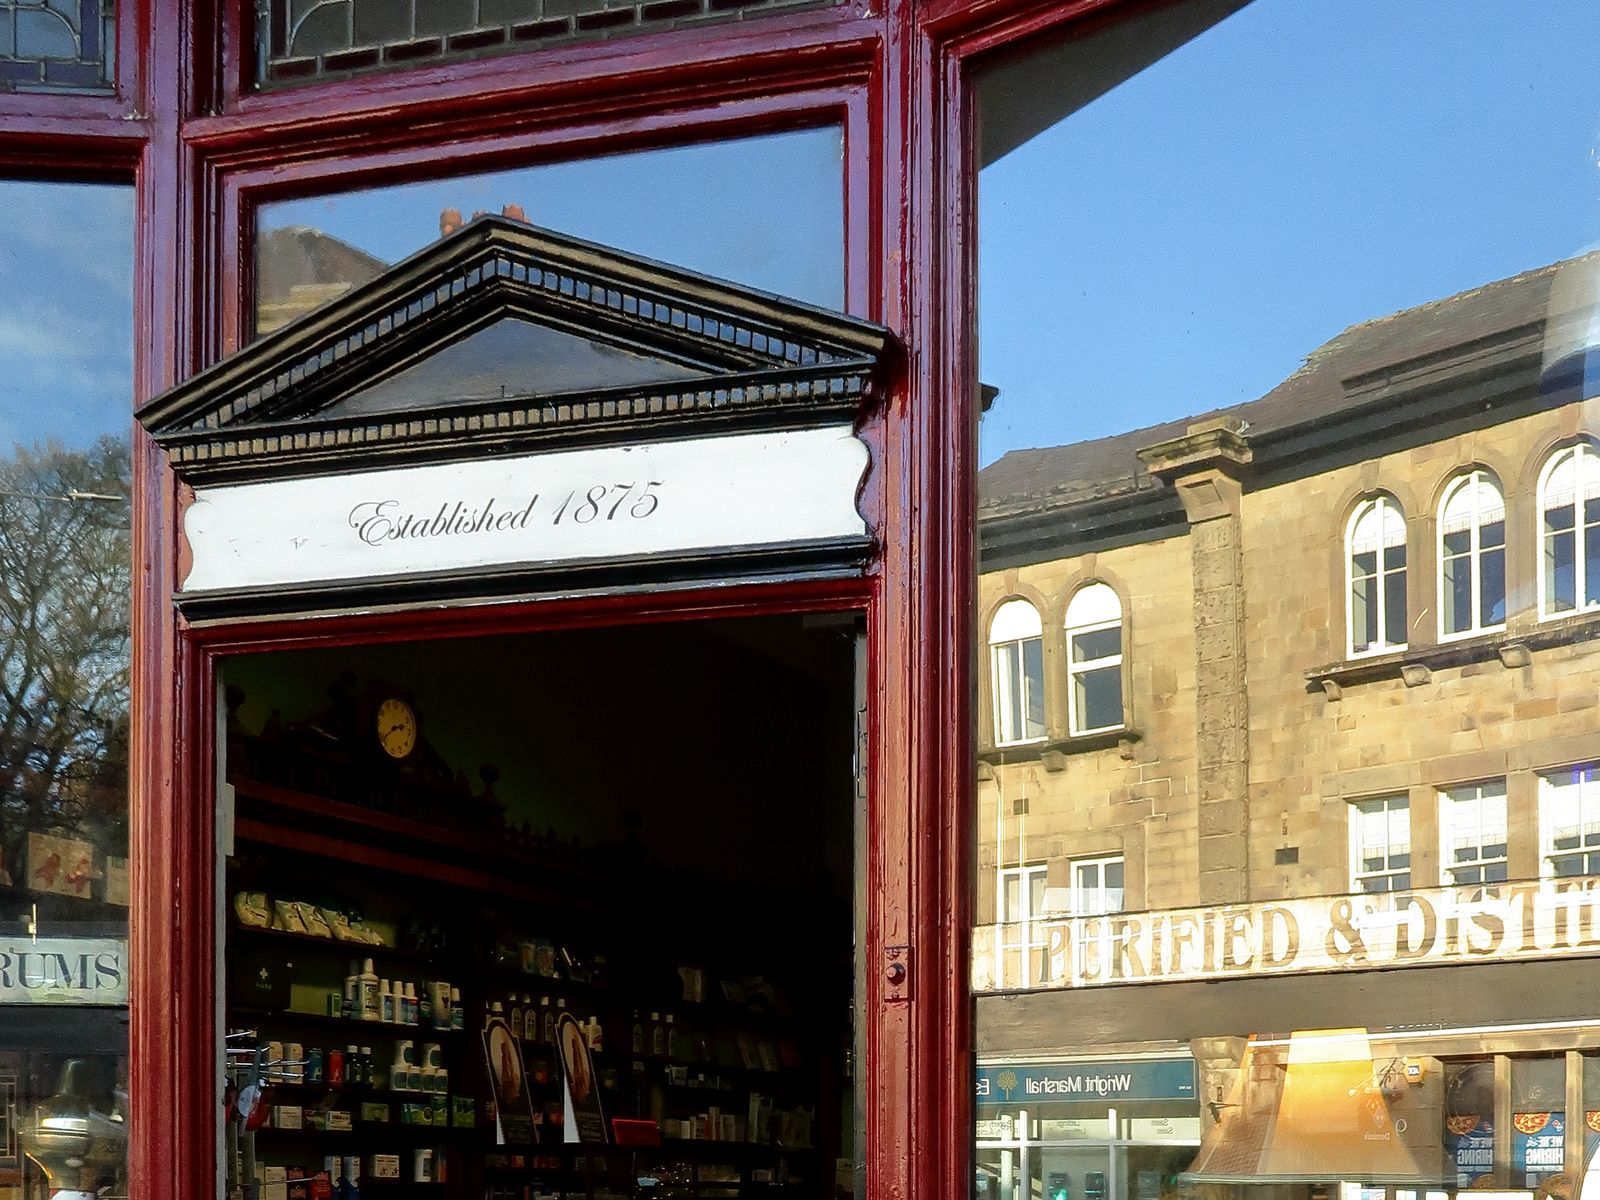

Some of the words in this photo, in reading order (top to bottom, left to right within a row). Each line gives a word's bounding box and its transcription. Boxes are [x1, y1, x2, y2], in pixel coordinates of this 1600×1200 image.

[348, 494, 539, 546] Established
[553, 479, 665, 526] 1875
[1040, 906, 1301, 983] PURIFIED
[1325, 899, 1372, 962] &
